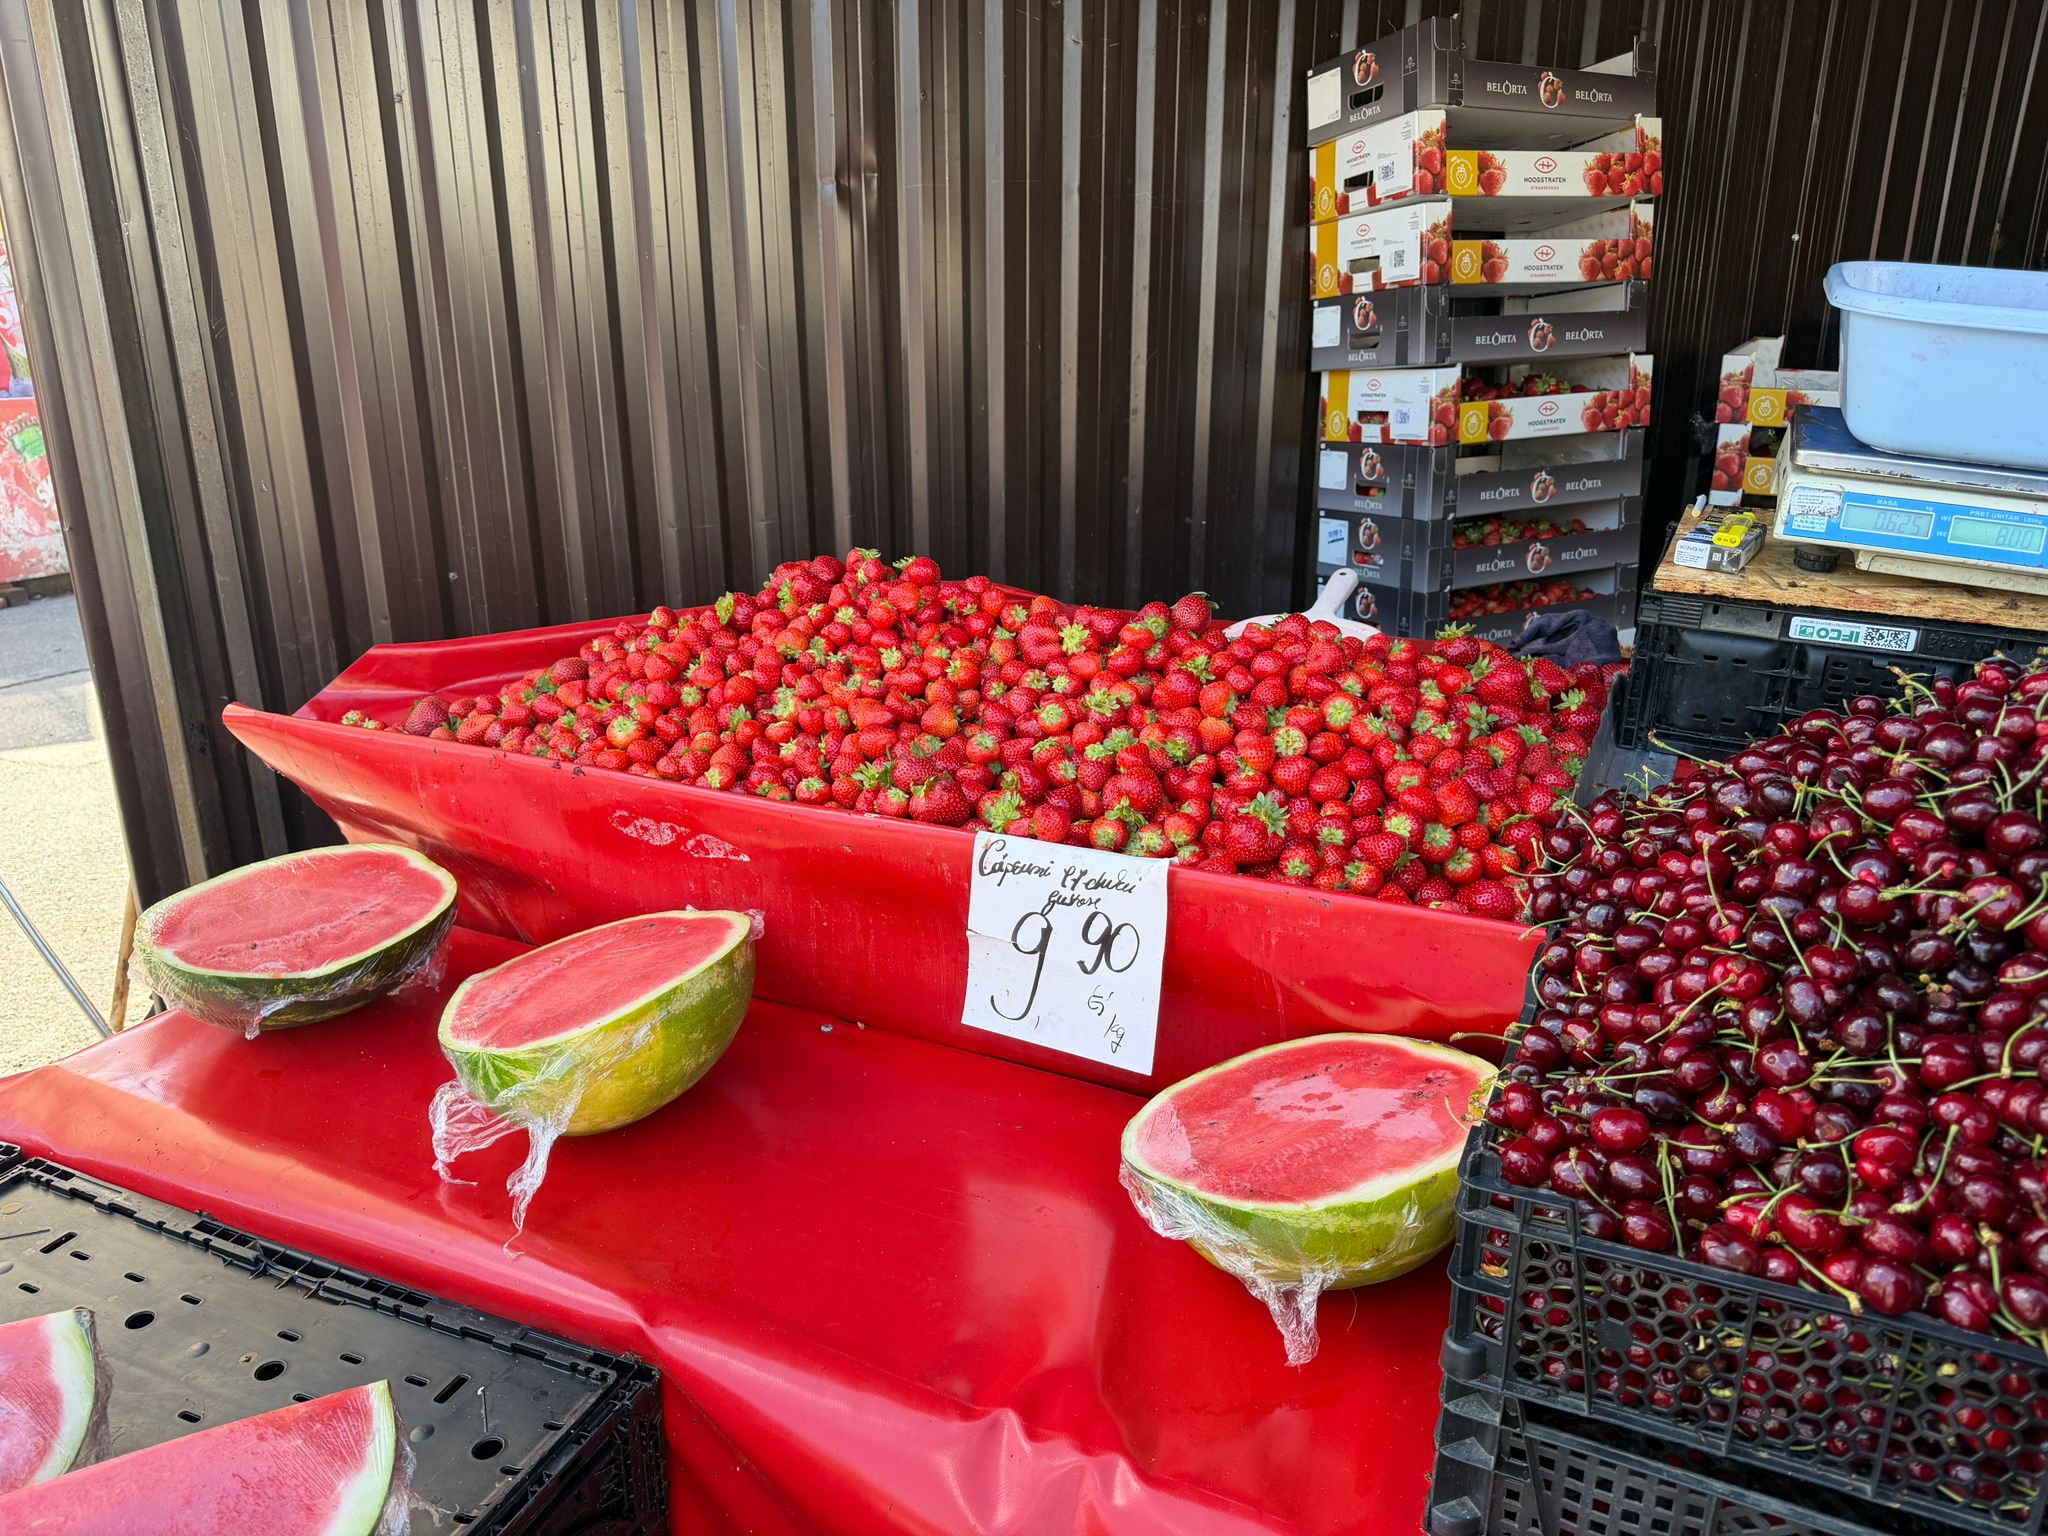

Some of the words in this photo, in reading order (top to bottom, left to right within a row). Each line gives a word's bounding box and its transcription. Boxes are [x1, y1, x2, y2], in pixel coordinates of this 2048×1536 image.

[1528, 417, 1567, 427] HOOGSTRATEN
[1876, 498, 1898, 506] MASA
[1991, 513, 2020, 522] UNITAR
[1815, 627, 1860, 643] IFCO
[1076, 910, 1140, 975] 90
